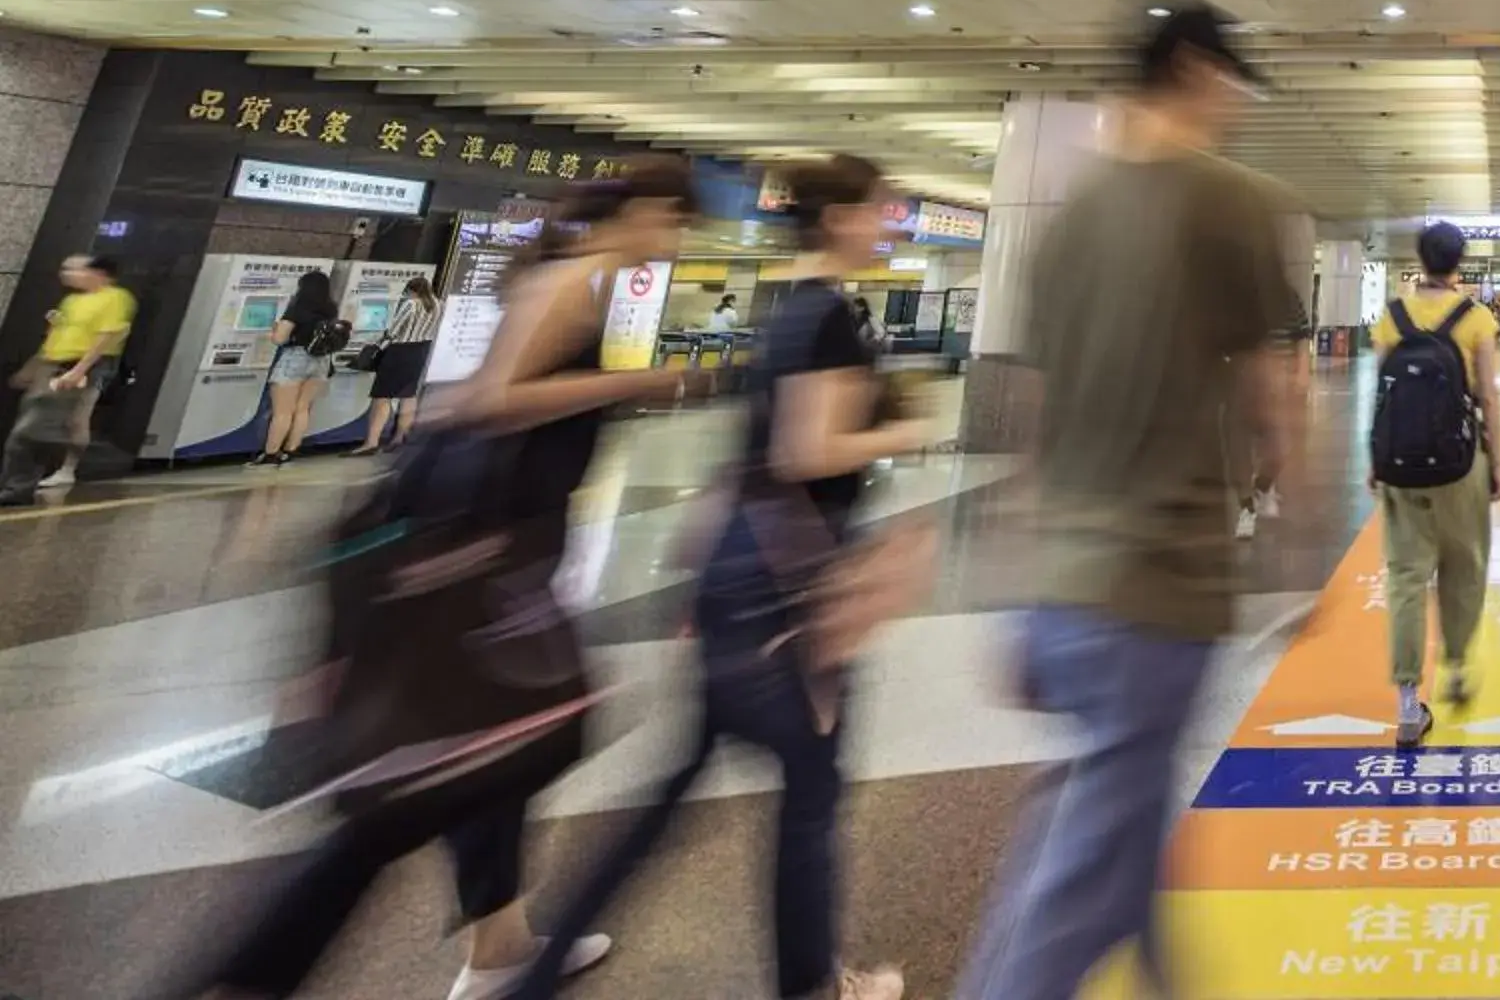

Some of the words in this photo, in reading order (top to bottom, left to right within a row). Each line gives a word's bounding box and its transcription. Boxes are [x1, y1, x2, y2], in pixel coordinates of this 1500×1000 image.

[189, 88, 352, 145] 品質政策
[378, 121, 446, 158] 安全
[1303, 780, 1382, 796] TRA
[1267, 851, 1370, 872] HSR
[1280, 948, 1391, 975] New
